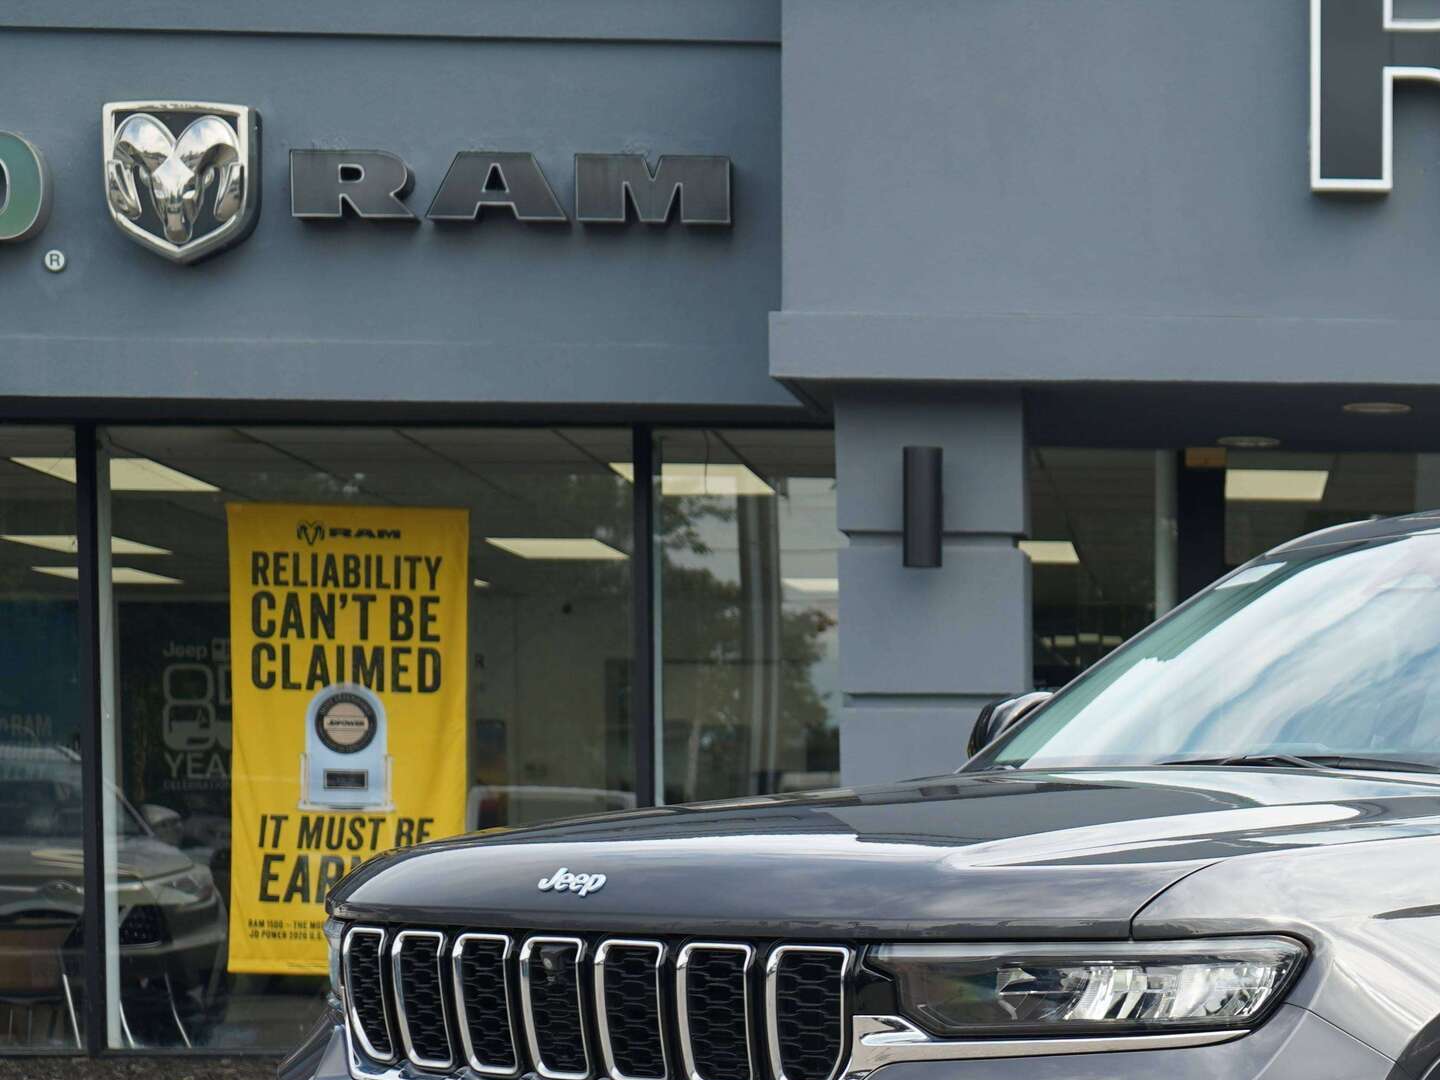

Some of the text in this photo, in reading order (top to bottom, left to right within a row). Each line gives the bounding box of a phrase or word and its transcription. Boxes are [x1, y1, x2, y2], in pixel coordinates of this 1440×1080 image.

[289, 149, 732, 225] RAM
[329, 528, 401, 539] RAM
[252, 551, 443, 591] RELIABILITY
[251, 591, 441, 642] CAN'T BE
[163, 641, 208, 660] Jeep
[251, 642, 442, 693] CLAIMED
[258, 814, 435, 850] IT MUST BE
[258, 854, 361, 904] EAR
[537, 866, 607, 897] Jeep
[248, 919, 265, 928] RAM
[293, 920, 307, 928] THE
[261, 930, 287, 939] POWER
